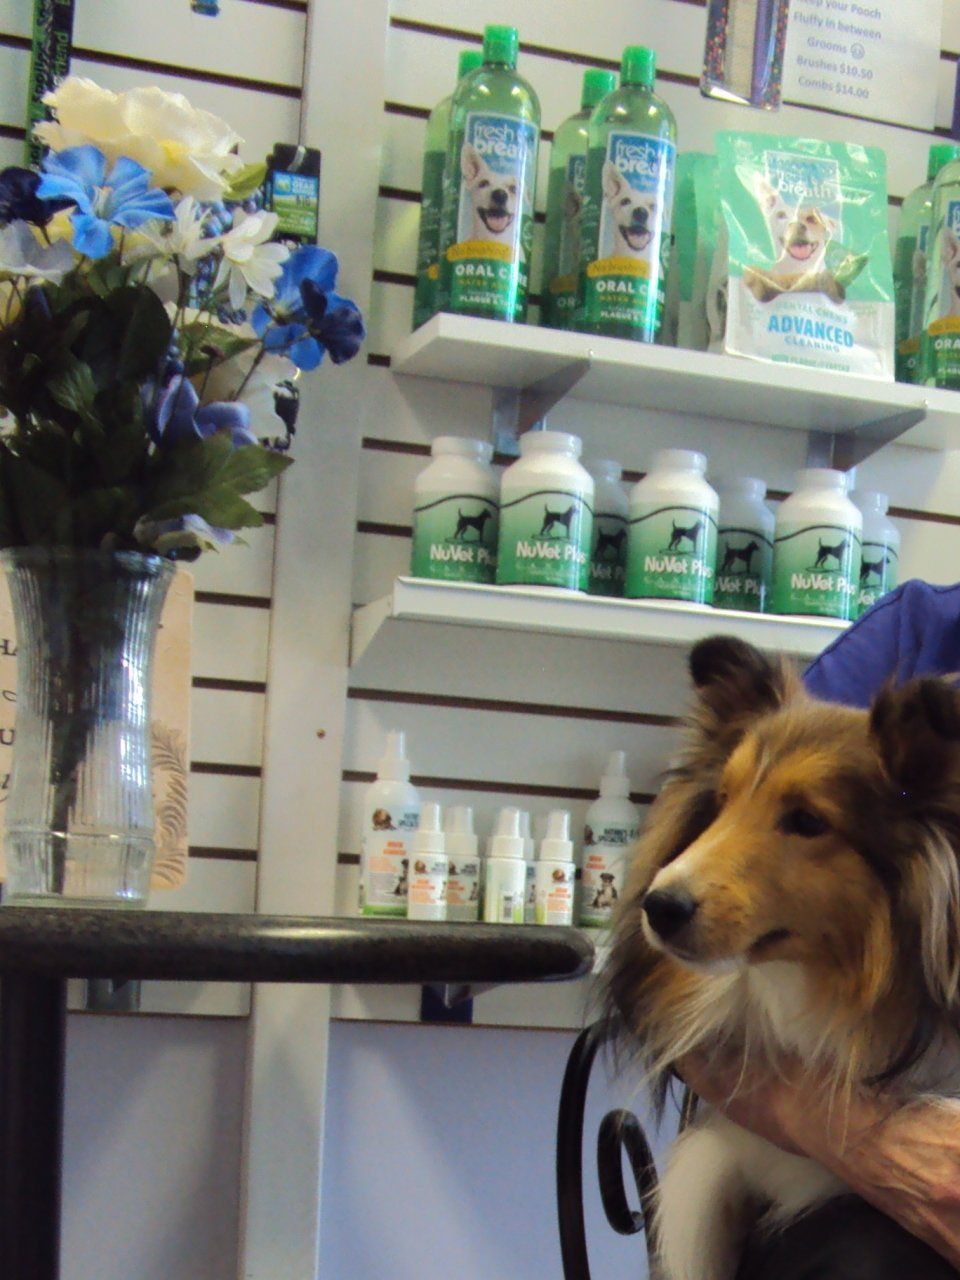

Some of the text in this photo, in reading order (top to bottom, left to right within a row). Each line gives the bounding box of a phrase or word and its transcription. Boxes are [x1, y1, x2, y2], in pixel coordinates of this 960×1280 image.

[826, 0, 848, 11] your
[851, 4, 881, 19] Pooch
[793, 12, 823, 27] Fluffy
[837, 20, 881, 39] between
[807, 37, 848, 54] Grooms
[796, 55, 873, 80] Brushes $10.50
[798, 76, 870, 99] Combs $14.00
[475, 120, 515, 141] fresh
[474, 139, 531, 159] brea
[616, 139, 656, 159] fresh
[616, 157, 672, 181] breah
[455, 264, 495, 278] ORAL
[498, 267, 528, 288] CRE
[596, 280, 666, 303] ORAL CRE
[557, 297, 575, 307] OR
[768, 314, 854, 348] ADVANCED
[784, 335, 841, 353] CLEANING
[429, 543, 474, 563] NuVet
[516, 541, 560, 560] NuVet
[591, 564, 612, 578] Vet
[644, 555, 688, 575] NuVet
[791, 573, 834, 591] NuVet
